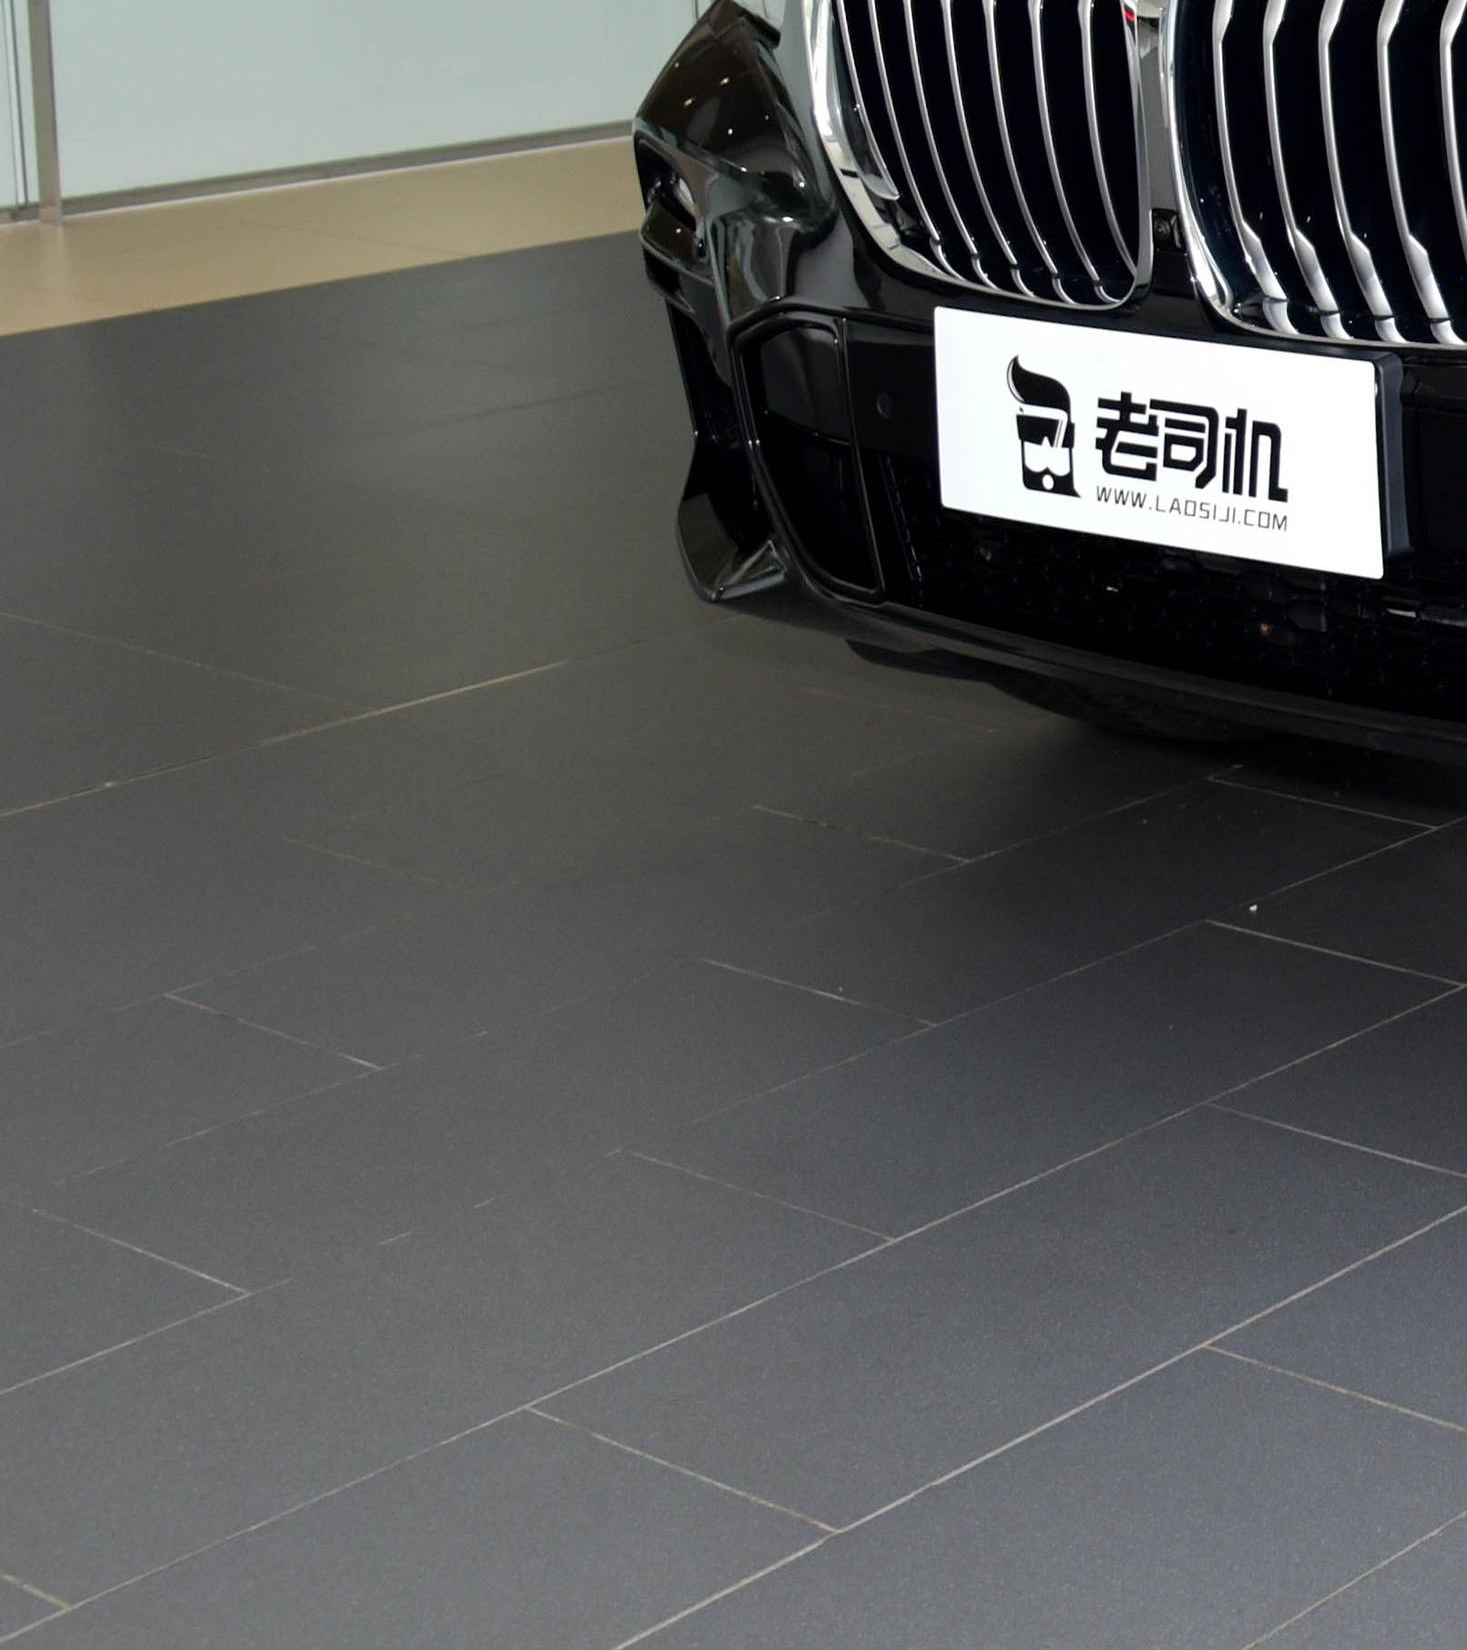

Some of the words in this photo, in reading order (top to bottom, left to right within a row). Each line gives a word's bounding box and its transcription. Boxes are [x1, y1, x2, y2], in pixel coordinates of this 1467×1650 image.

[1095, 391, 1288, 503] 老司机
[1096, 485, 1288, 532] WWW.LAOSIJI.COM
